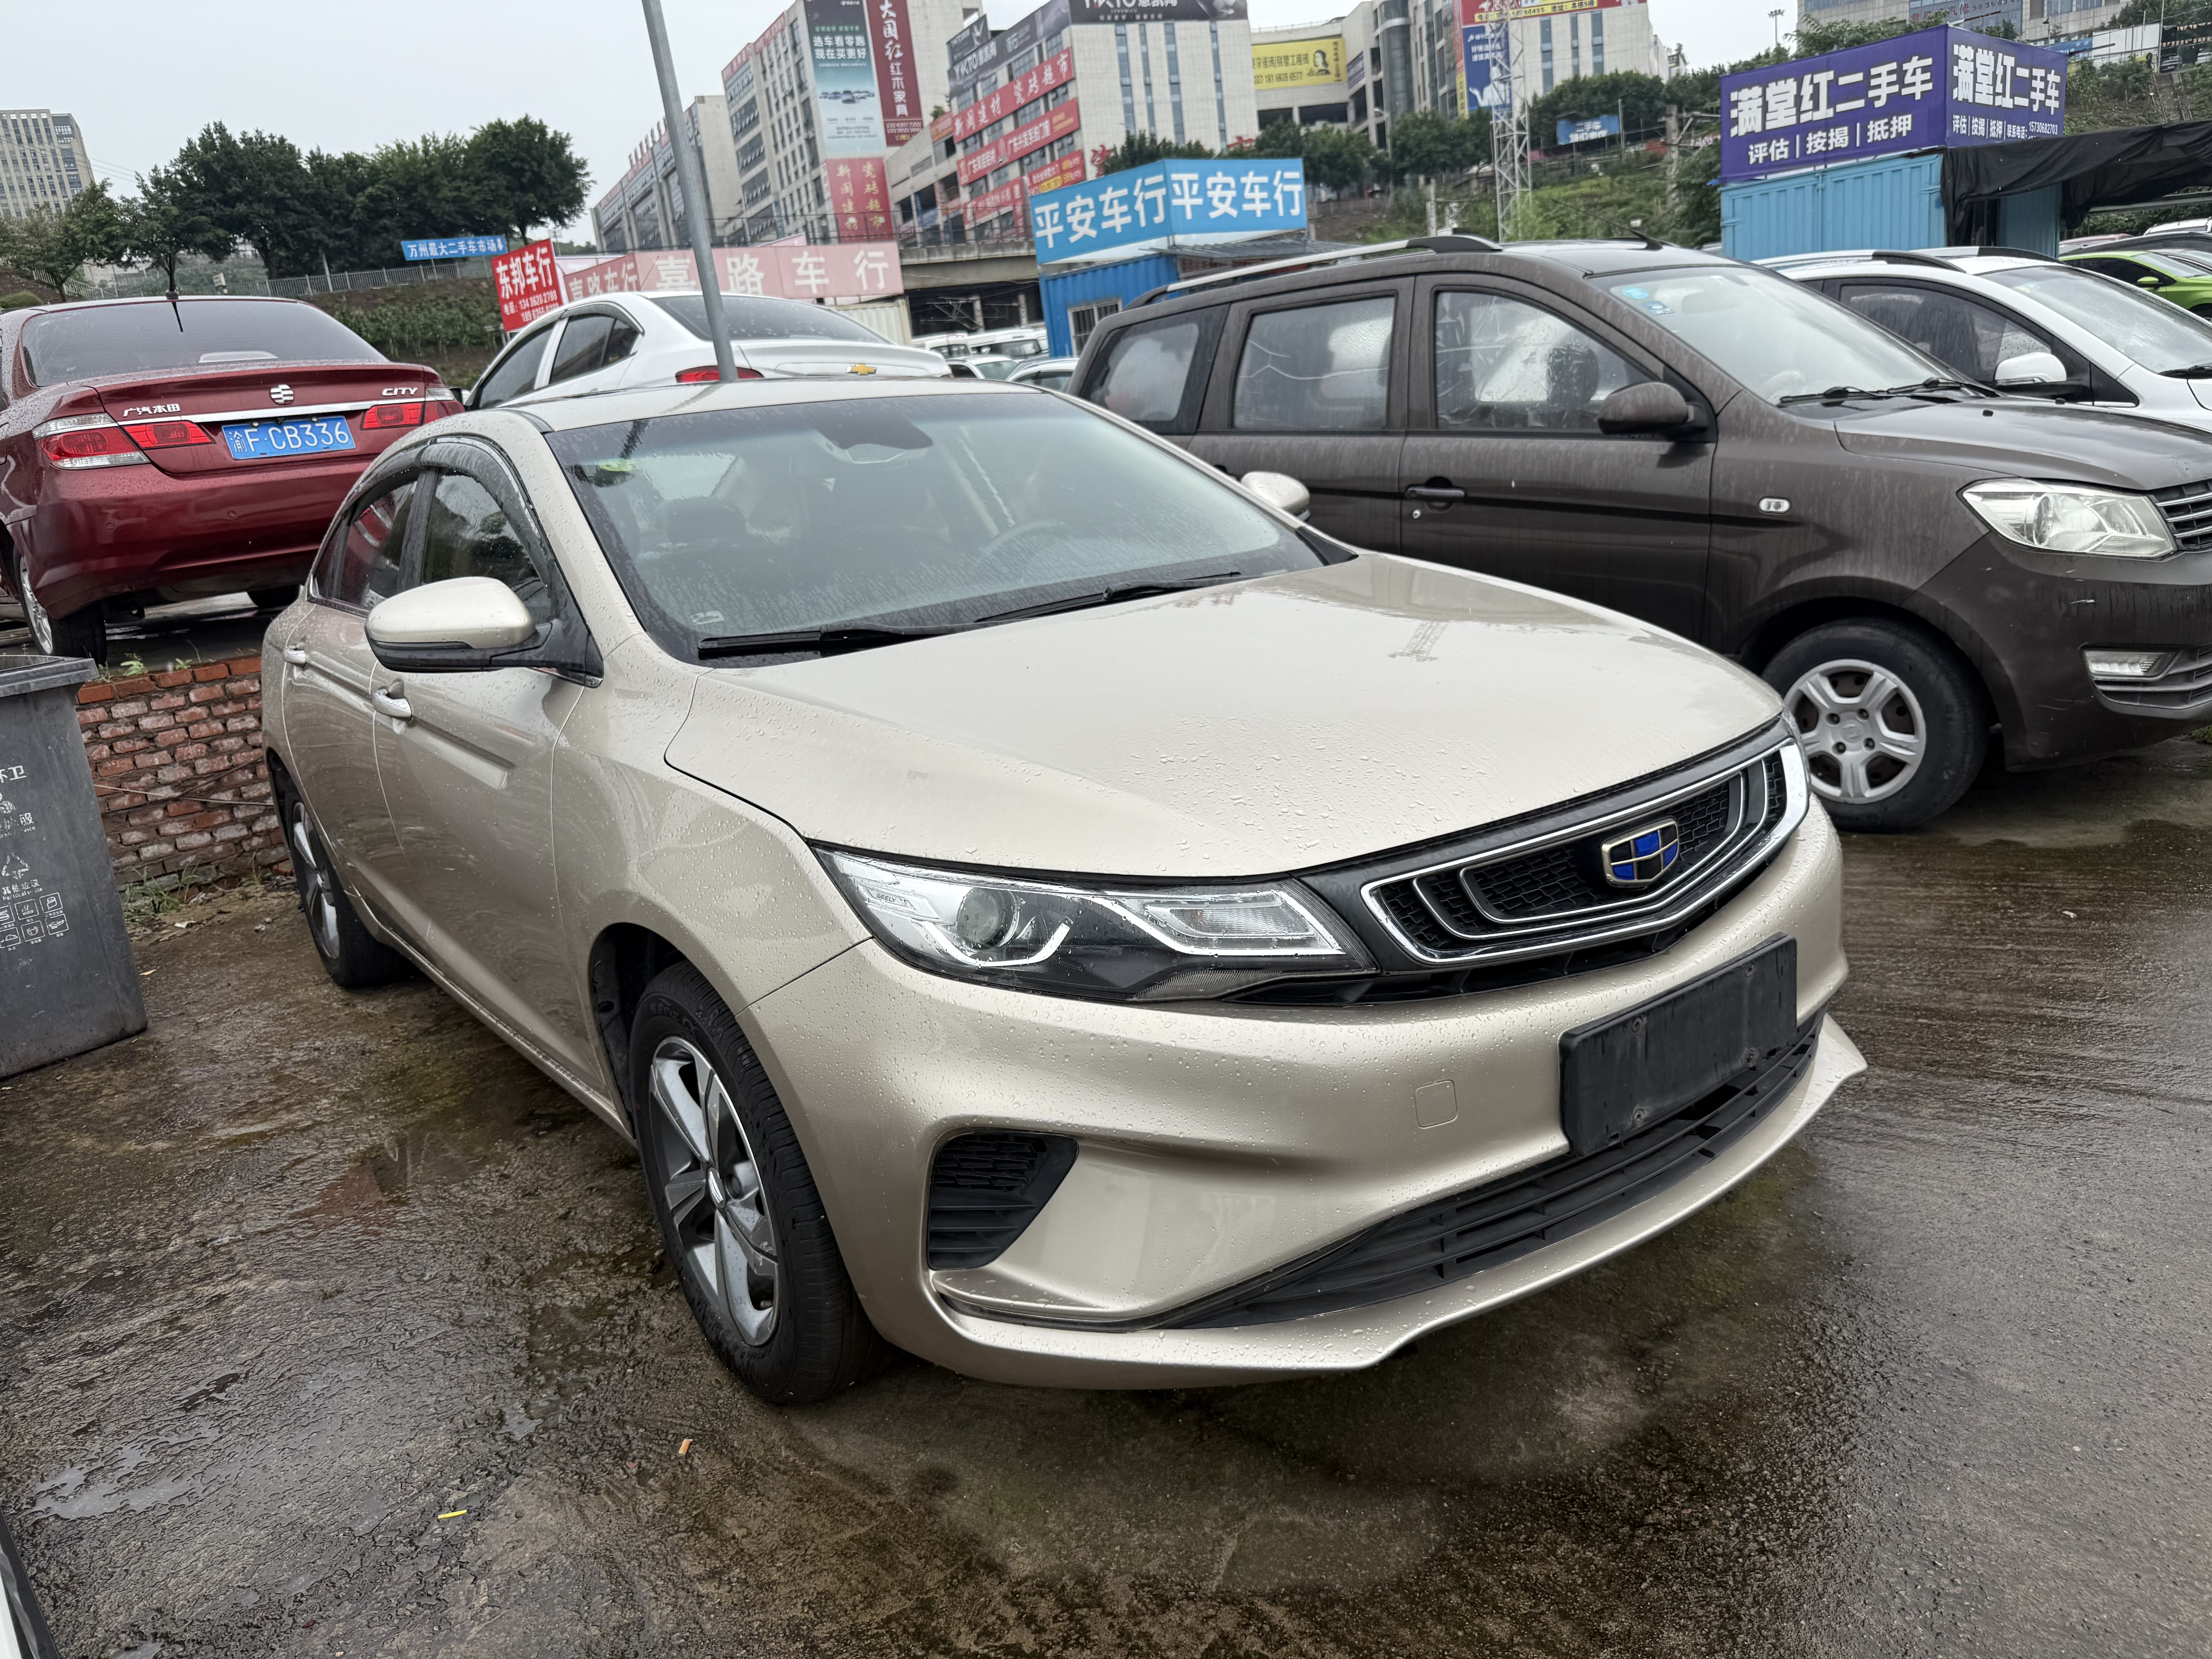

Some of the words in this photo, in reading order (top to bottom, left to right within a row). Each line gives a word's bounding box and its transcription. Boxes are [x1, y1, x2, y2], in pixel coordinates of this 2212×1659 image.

[815, 48, 866, 59] 现在买更好
[890, 62, 908, 117] 红木家具
[1730, 56, 1933, 137] 满堂红二手车
[1953, 44, 2060, 115] 满堂红二手车
[1748, 138, 1790, 165] 评估
[1806, 127, 1848, 154] 按揭
[1867, 114, 1911, 143] 抵押
[1953, 115, 1967, 135] 评估
[1972, 117, 1985, 137] 按揭
[1989, 119, 2002, 139] 抵押
[2029, 121, 2058, 135] 15730682703
[1035, 175, 1166, 248] 平安车行
[1171, 171, 1302, 220] 平安车行
[407, 239, 497, 258] 万州最大二手车市场
[496, 246, 553, 300] 东邦车行
[123, 403, 180, 417] 广汽本田
[382, 387, 418, 396] CITY
[877, 893, 896, 903] GEELY
